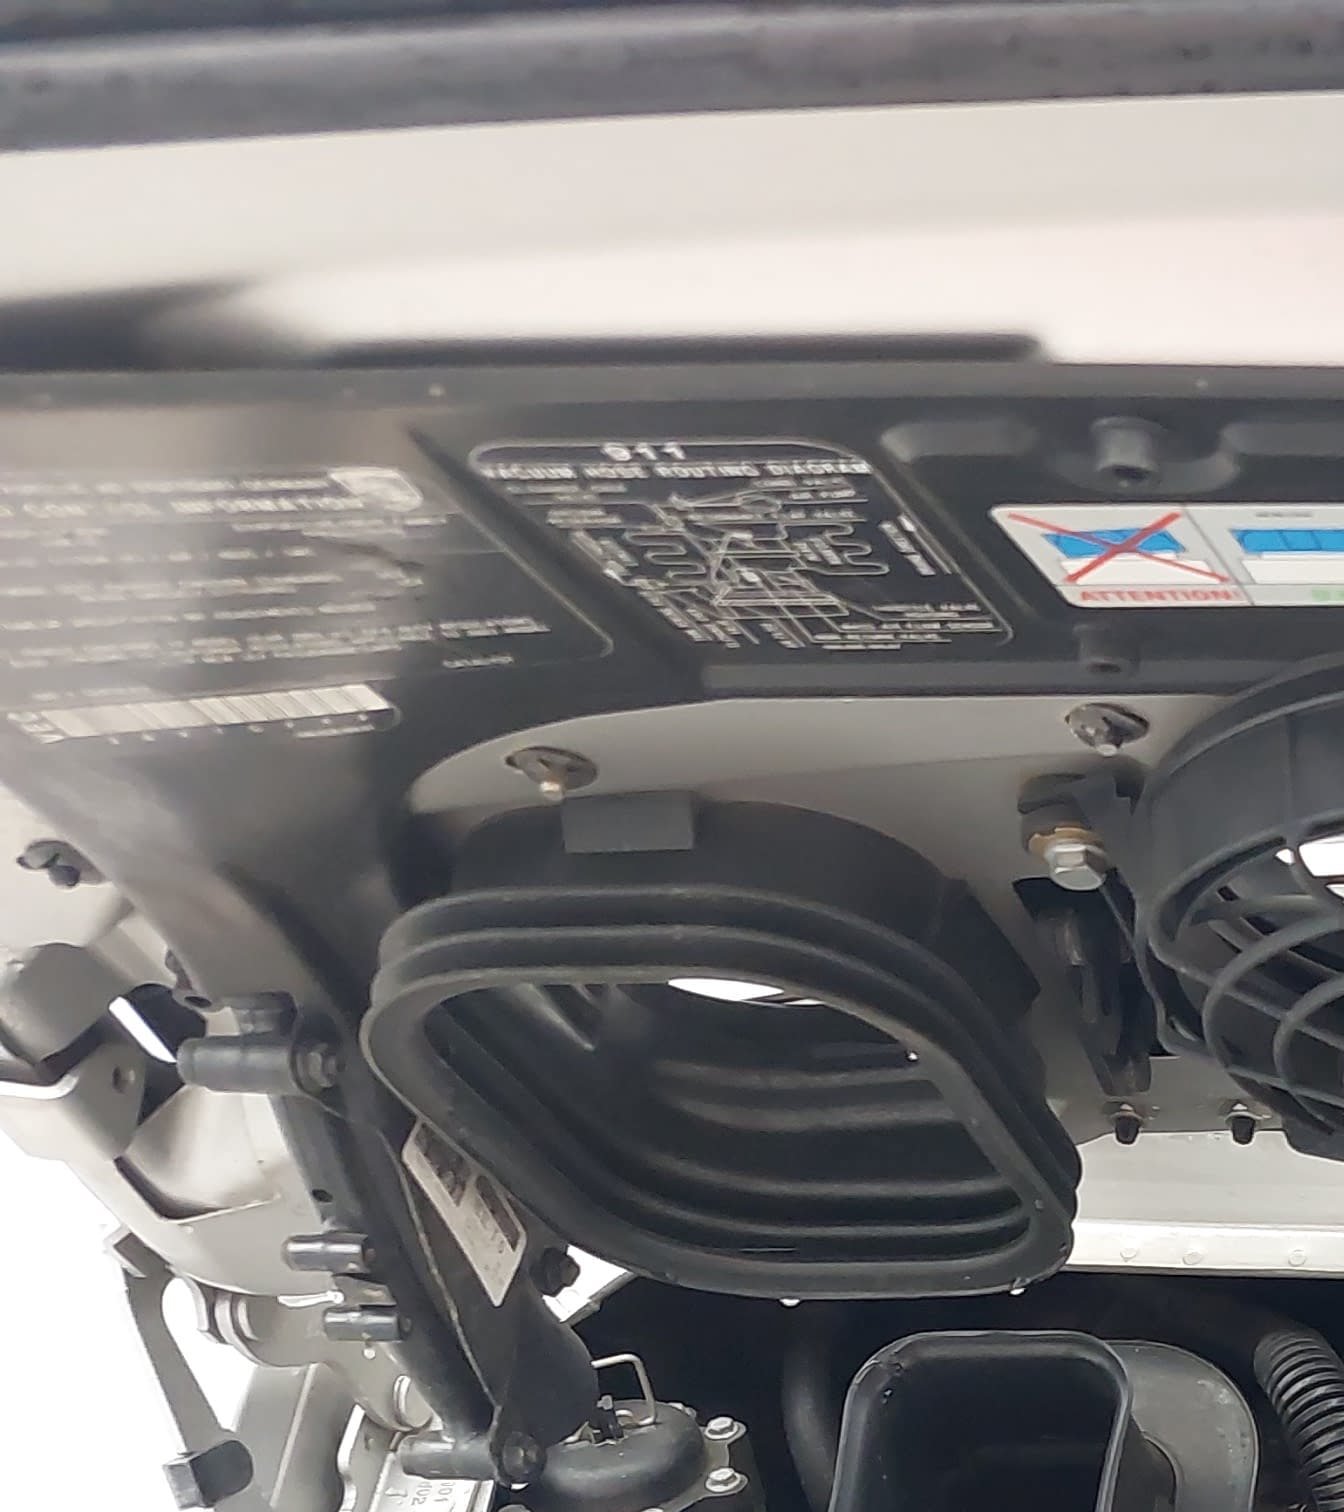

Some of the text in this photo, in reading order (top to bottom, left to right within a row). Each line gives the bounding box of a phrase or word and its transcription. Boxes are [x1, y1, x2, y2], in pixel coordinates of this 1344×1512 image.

[654, 461, 761, 478] ROUTING
[764, 459, 872, 475] DIAGRAM
[1080, 588, 1232, 602] ATTENTION
